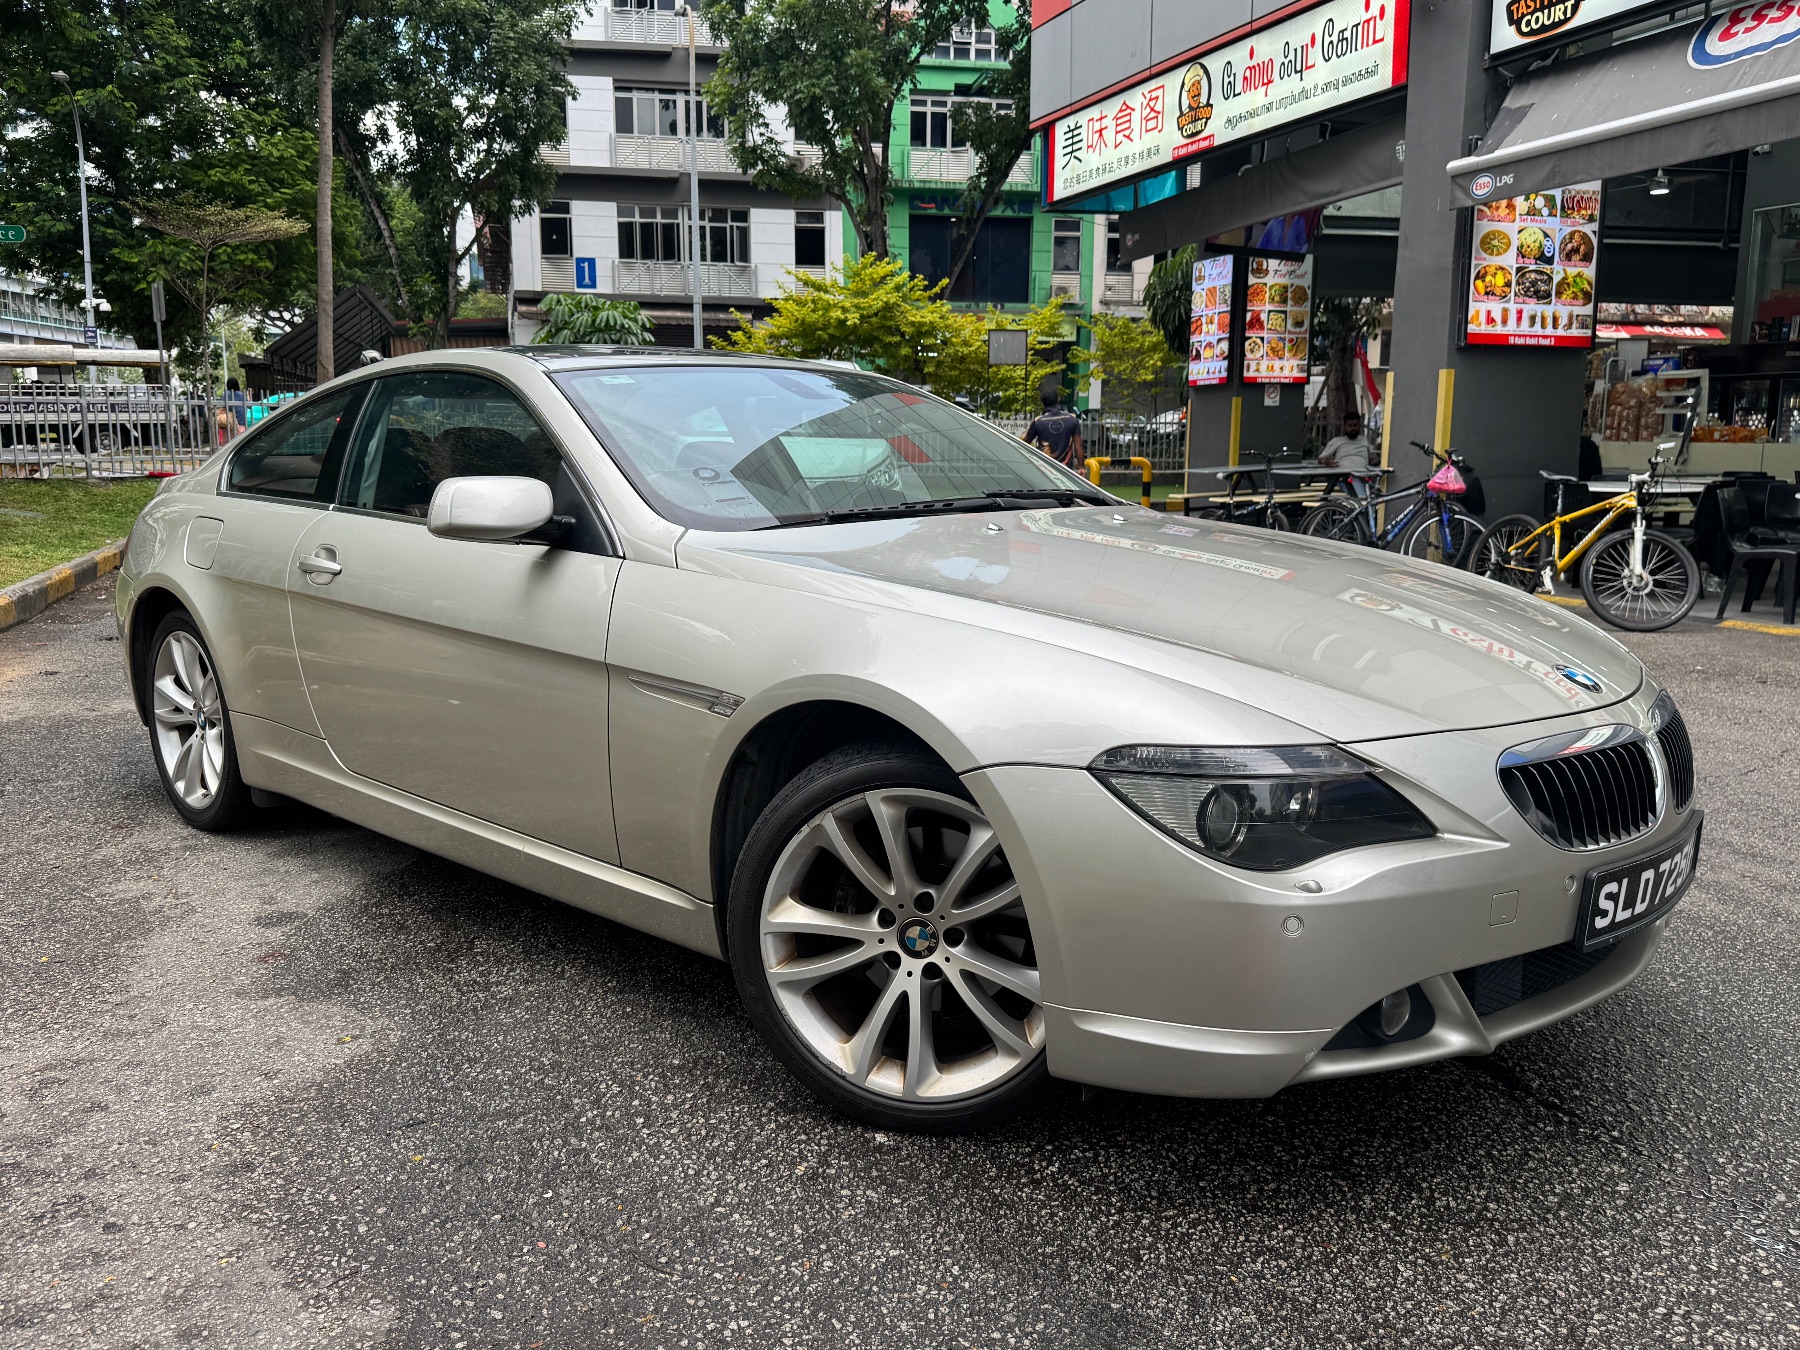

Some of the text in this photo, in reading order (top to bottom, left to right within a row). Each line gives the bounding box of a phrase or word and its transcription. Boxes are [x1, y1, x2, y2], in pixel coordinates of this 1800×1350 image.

[1521, 0, 1575, 33] COURT
[1222, 45, 1275, 101] டேஸ்டி
[1062, 84, 1165, 170] 美味食阁
[1178, 106, 1211, 128] TASTY FOOD
[1183, 118, 1206, 137] COURT
[1496, 173, 1515, 187] LPG
[580, 261, 592, 285] 1
[1594, 829, 1698, 930] SLD 725
